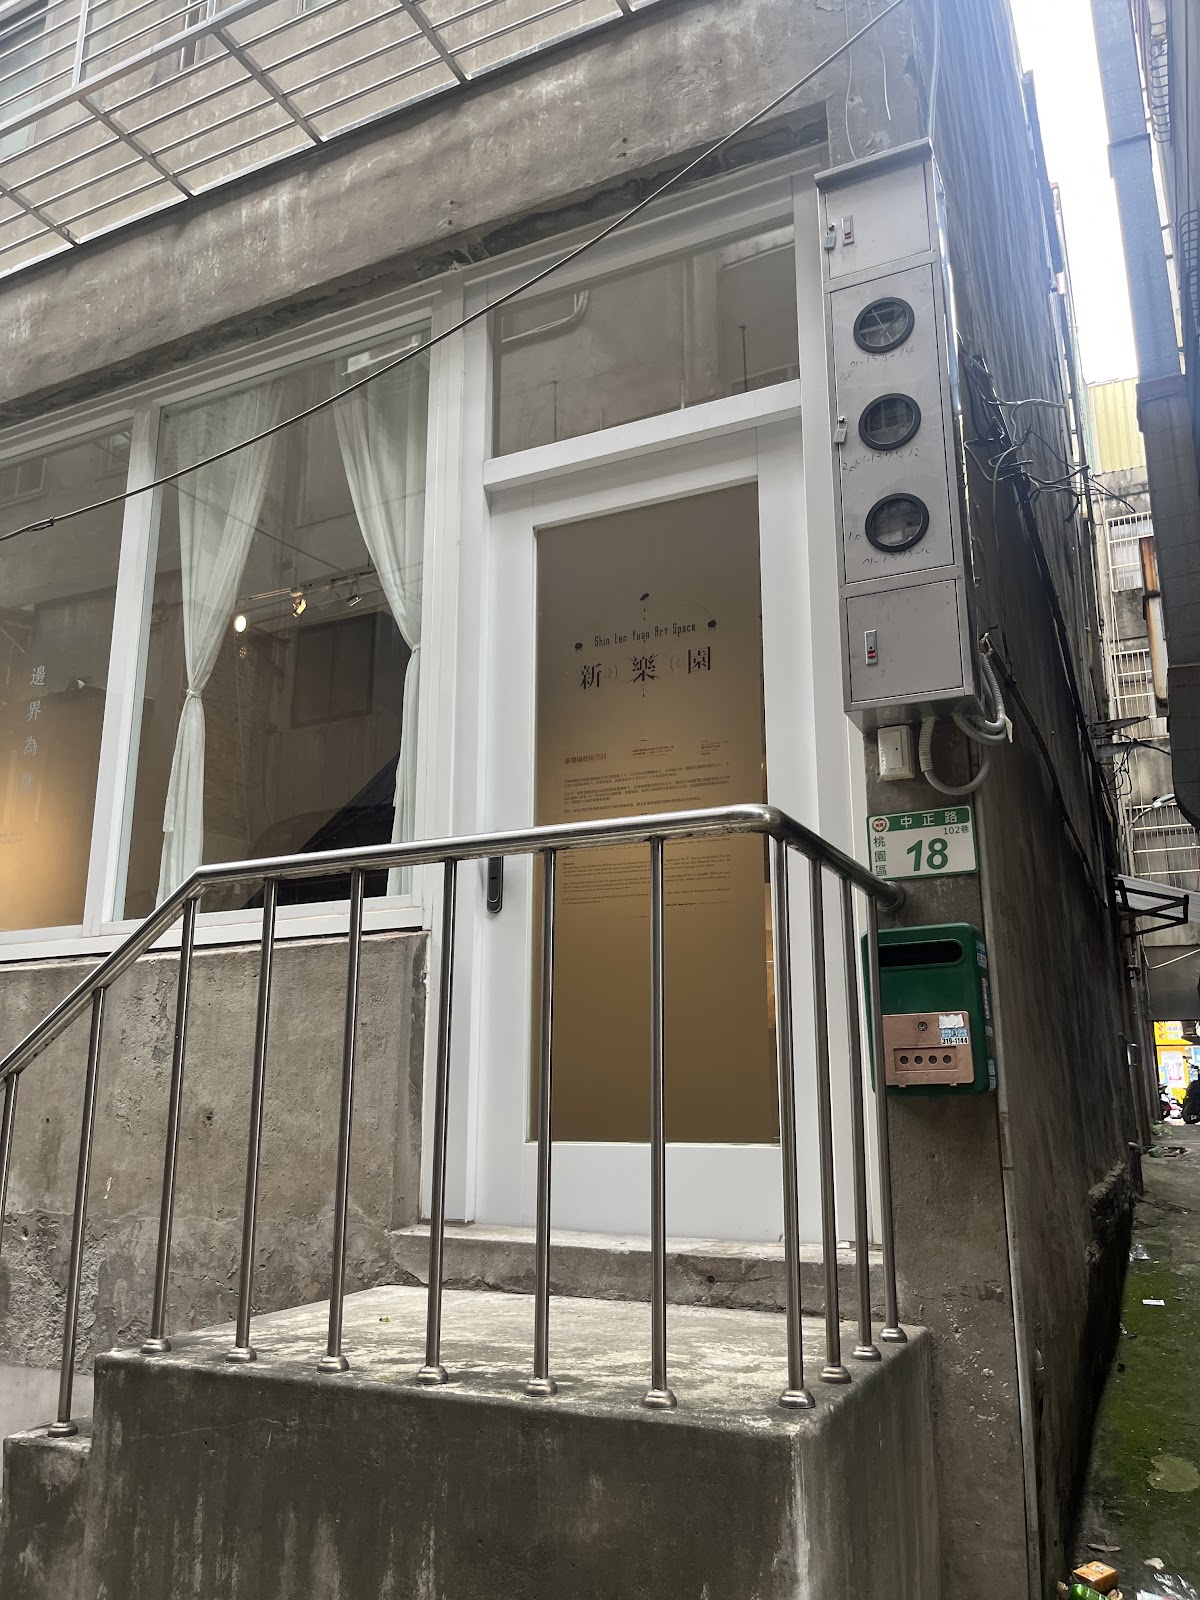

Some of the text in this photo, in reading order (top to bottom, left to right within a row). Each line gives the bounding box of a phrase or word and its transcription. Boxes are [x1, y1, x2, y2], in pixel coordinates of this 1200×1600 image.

[594, 635, 610, 648] Shin
[632, 630, 650, 641] Yuan
[654, 625, 668, 637] Art
[672, 622, 696, 637] Space
[579, 646, 711, 690] 新樂園
[900, 810, 958, 829] 中正路
[943, 825, 970, 835] 102巷
[873, 835, 887, 876] 桃園區
[906, 837, 949, 872] 18
